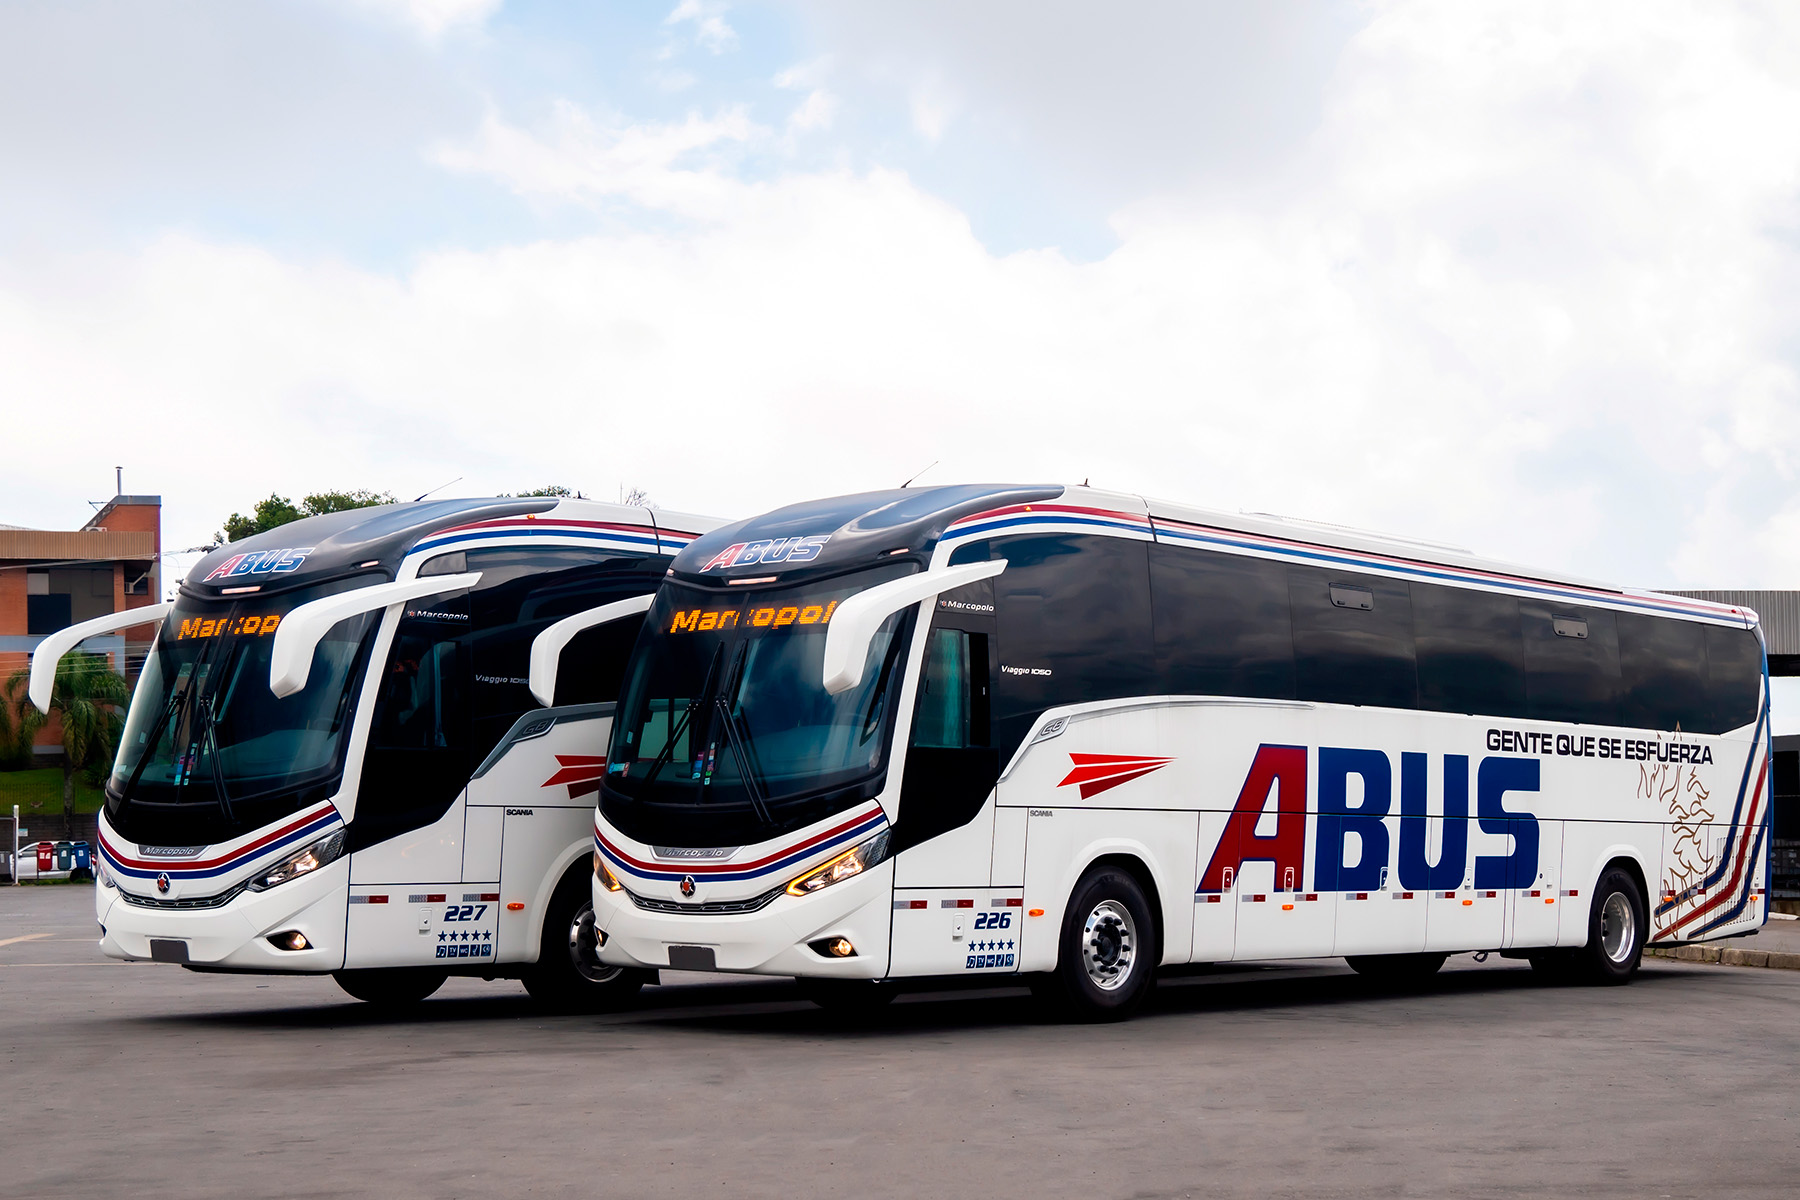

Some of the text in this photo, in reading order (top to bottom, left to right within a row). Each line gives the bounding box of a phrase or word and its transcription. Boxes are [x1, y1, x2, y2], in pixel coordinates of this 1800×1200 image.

[699, 535, 832, 573] ABUS
[202, 547, 316, 582] ABUS
[947, 600, 995, 612] Marcopolo
[416, 610, 469, 620] Marcopolo
[1001, 665, 1052, 676] Viaggio 1050
[475, 674, 508, 684] Viaggio
[1486, 728, 1714, 765] GENTE QUE SE ESFUERZA
[1195, 743, 1541, 893] ABUS
[144, 847, 195, 856] Marcopolo
[662, 848, 723, 857] Marcopolo
[444, 905, 488, 921] 227
[974, 912, 1012, 929] 226
